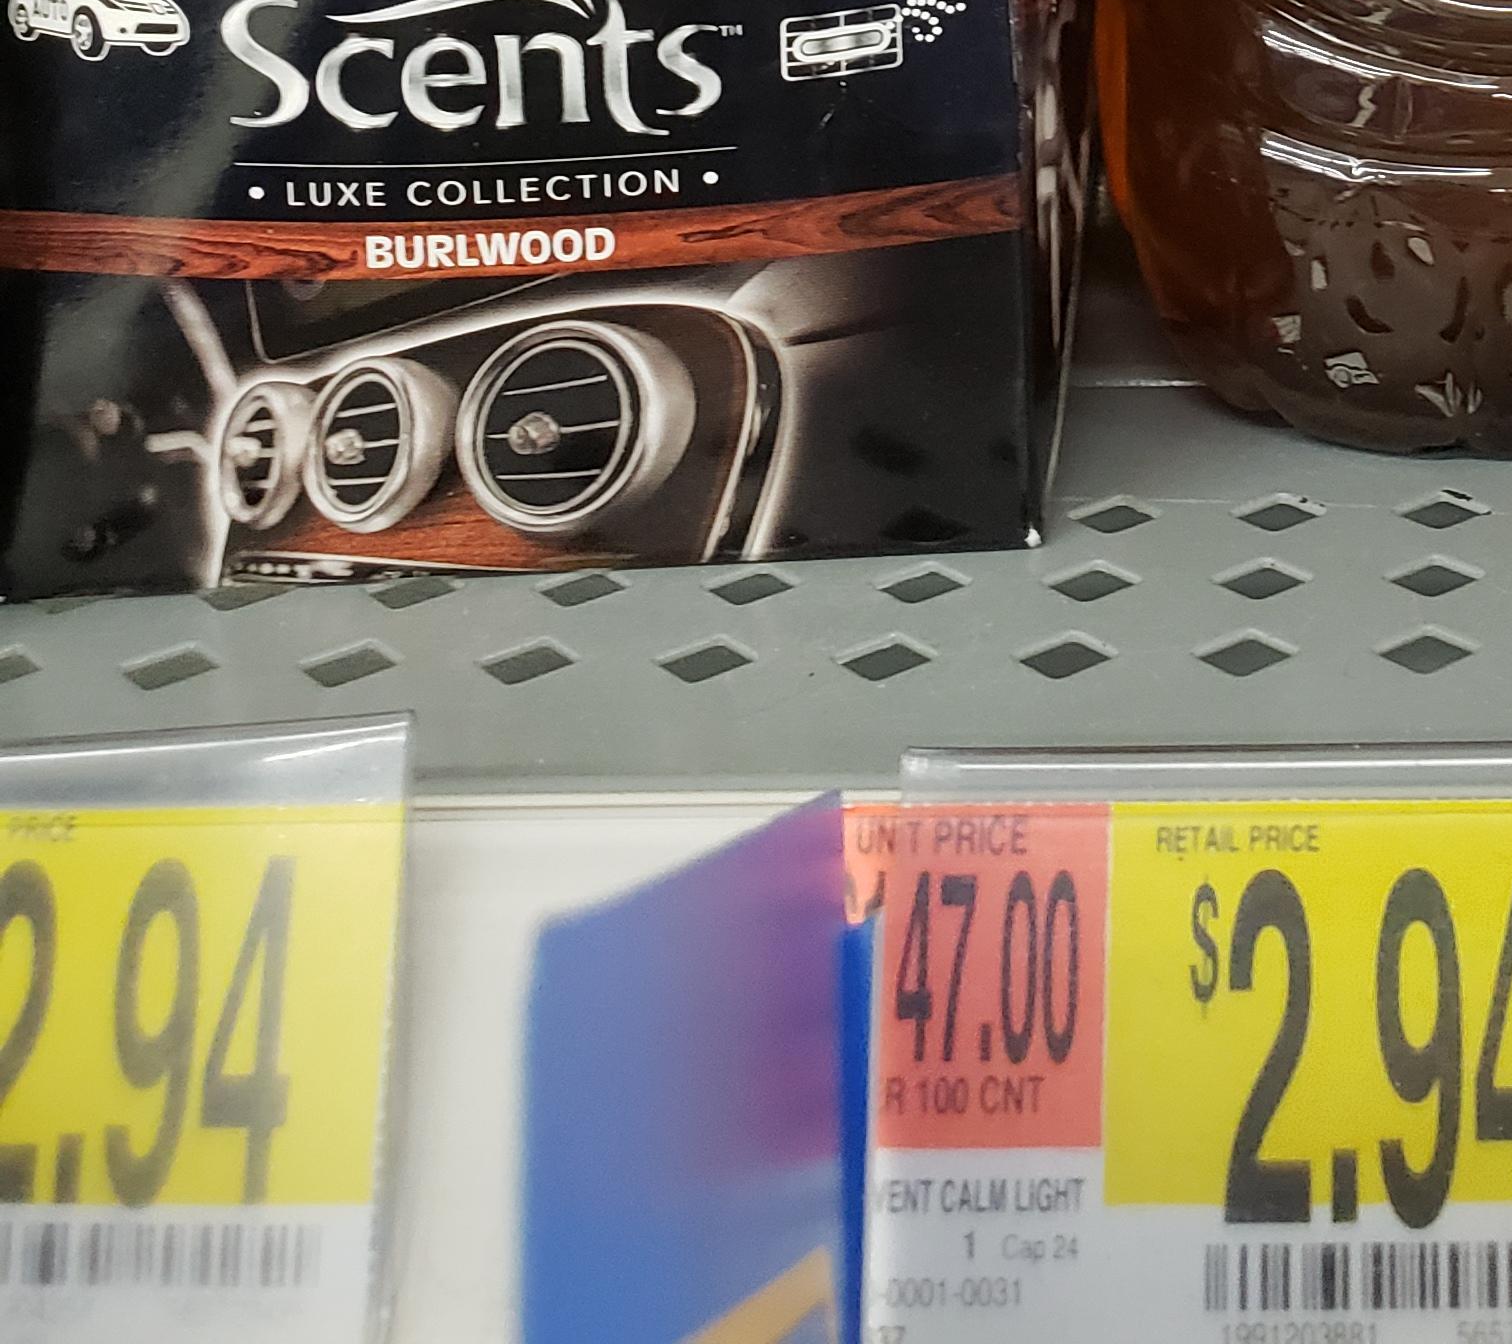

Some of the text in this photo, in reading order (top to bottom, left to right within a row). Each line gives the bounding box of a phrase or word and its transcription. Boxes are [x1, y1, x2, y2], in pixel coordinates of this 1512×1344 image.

[285, 168, 683, 209] LUXE COLLECTION
[364, 226, 617, 270] BURLWOOD
[856, 815, 1029, 856] UNT PRICE
[1156, 824, 1321, 854] RETAIL PRICE
[895, 869, 1081, 1064] 47.00
[918, 1076, 971, 1115] 100
[979, 1074, 1046, 1115] CNT
[940, 1178, 1008, 1213] CALM
[1014, 1177, 1086, 1213] LIGHT
[963, 1230, 1080, 1268] 1 Cap 24
